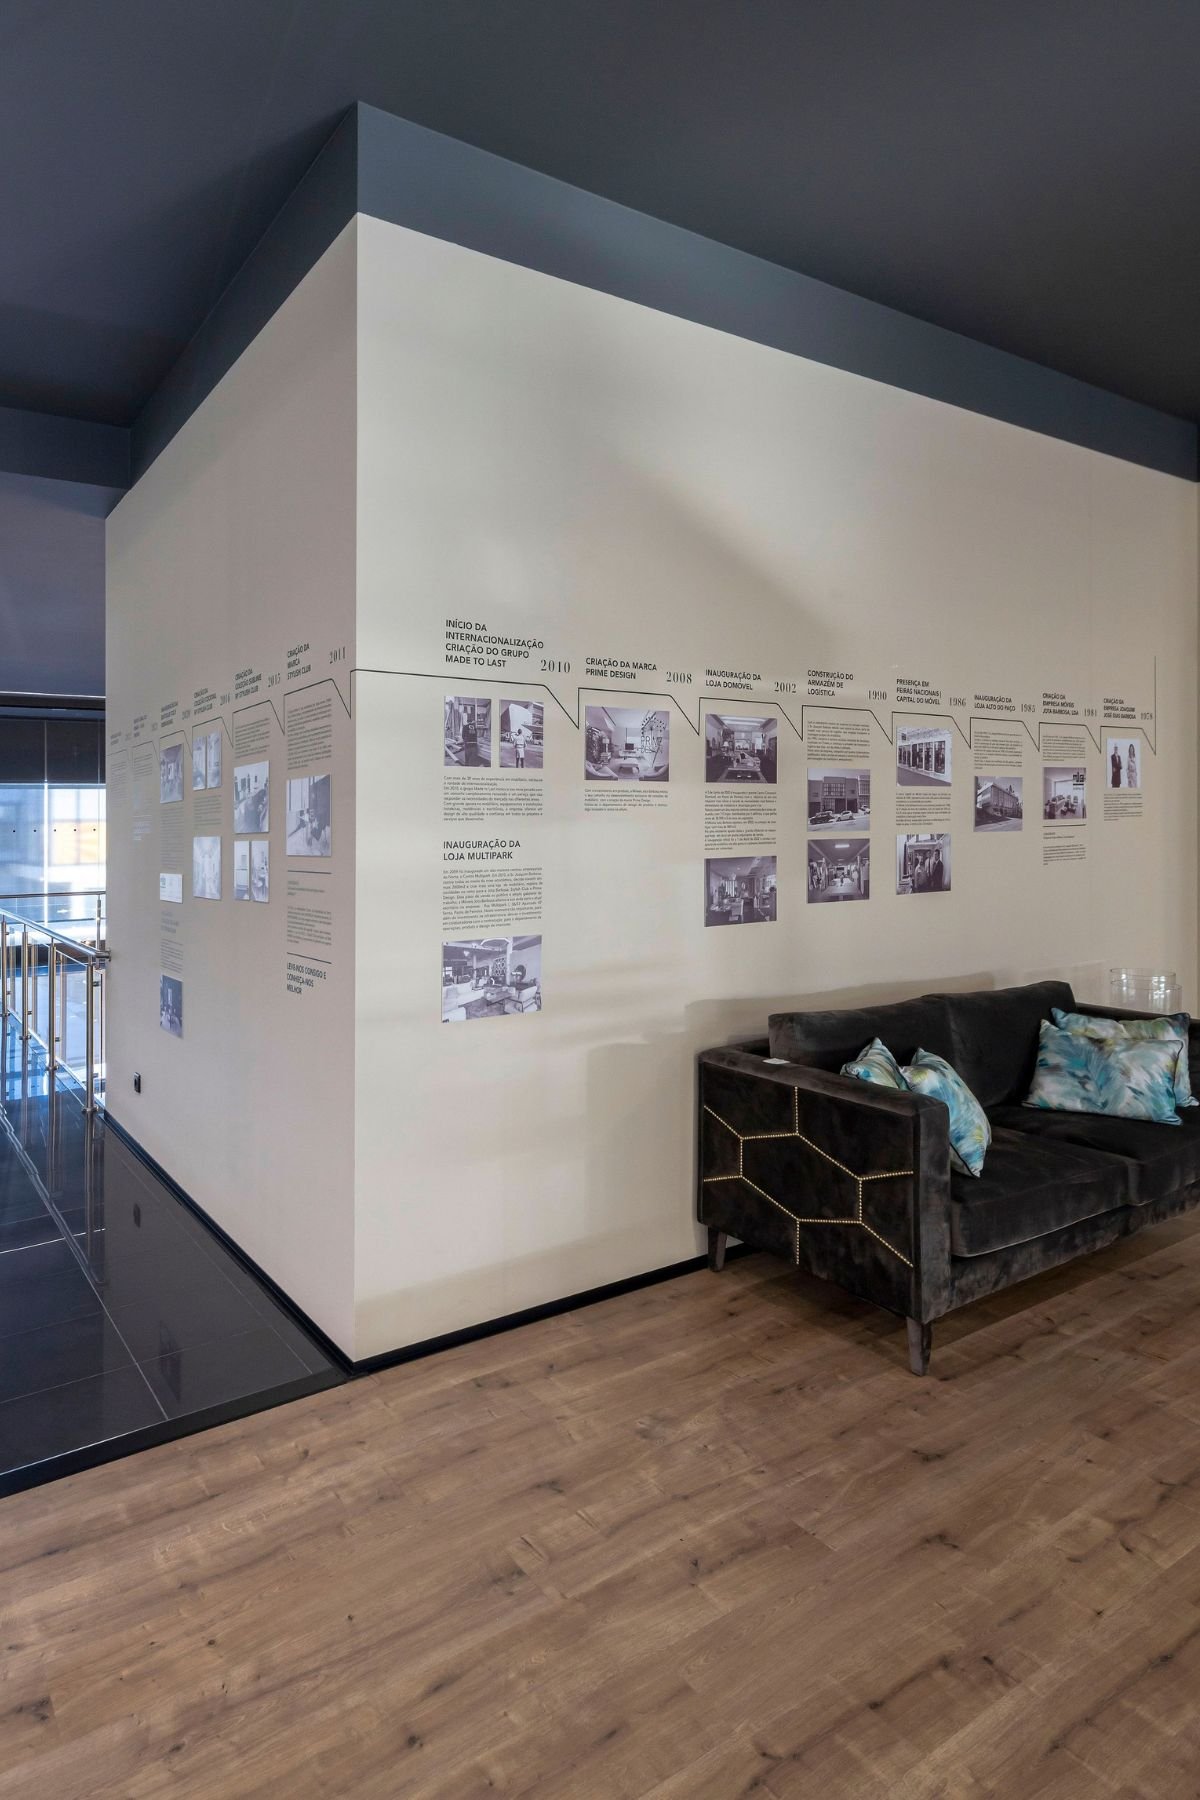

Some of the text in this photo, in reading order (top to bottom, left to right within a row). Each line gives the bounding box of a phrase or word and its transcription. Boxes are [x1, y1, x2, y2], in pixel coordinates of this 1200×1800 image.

[446, 619, 487, 631] INÍCIO DA
[446, 632, 544, 649] INTERNACIONALIZAÇÃO
[446, 643, 529, 658] CRIAÇÃO DO GRUPO
[446, 655, 471, 664] MADE
[487, 659, 506, 667] LAST
[540, 660, 570, 673] 2010
[586, 658, 618, 668] CRIAÇÃO
[632, 662, 657, 671] MARCA
[586, 668, 636, 679] PRIME DESIGN
[666, 672, 692, 684] 2008
[706, 669, 751, 681] INAUGURAÇÃO
[808, 670, 844, 680] CONSTRUÇÃO
[774, 682, 796, 693] 2002
[808, 679, 835, 688] ARMAZÉM
[896, 678, 921, 687] PRESENÇA
[808, 688, 835, 697] LOGÍSTICA
[444, 839, 506, 850] INAUGURAÇÃO
[468, 852, 512, 860] MULTIPARK
